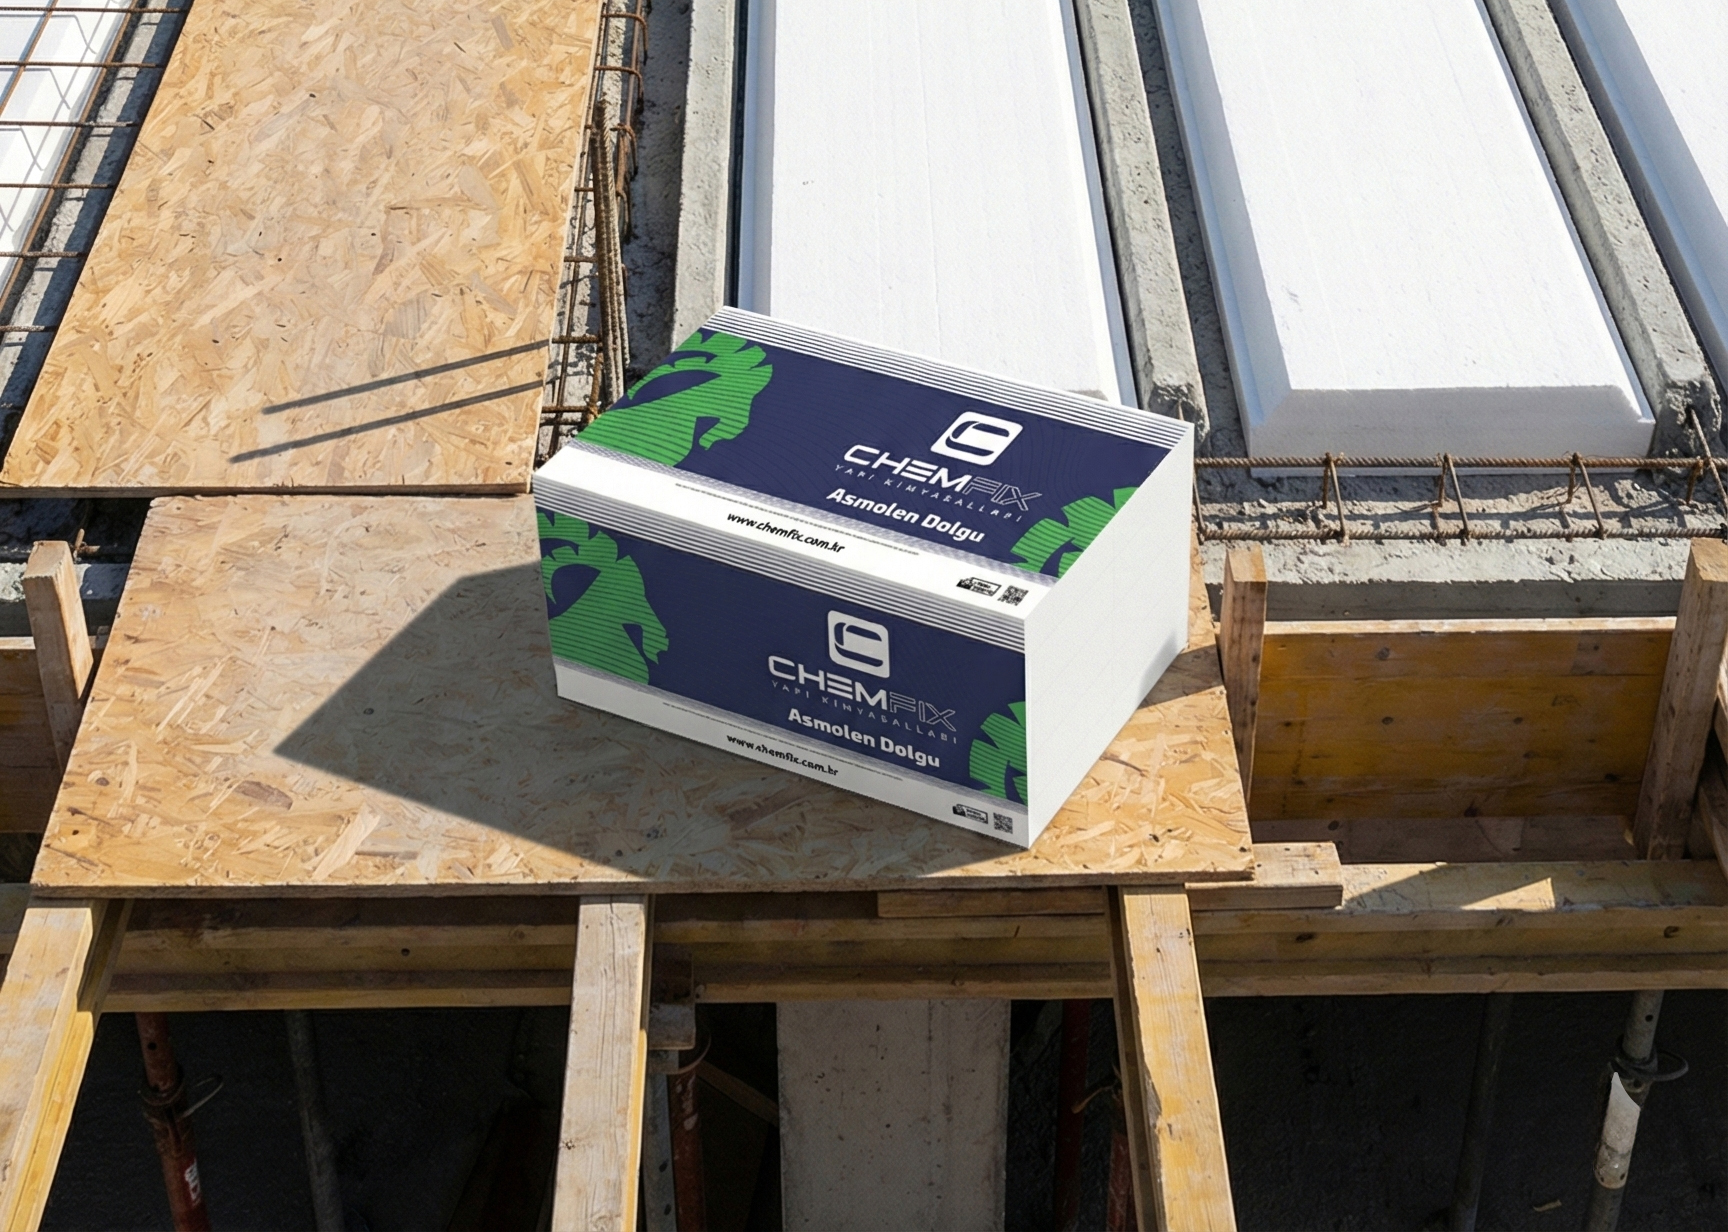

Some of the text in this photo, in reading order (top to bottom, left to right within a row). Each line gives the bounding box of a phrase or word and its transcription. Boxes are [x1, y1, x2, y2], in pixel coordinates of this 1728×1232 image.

[843, 444, 1043, 512] CHEMFIX
[826, 488, 920, 524] Asmolen
[921, 513, 985, 543] Dolgu
[768, 655, 957, 732] CHEMFIX
[788, 708, 875, 747] Asmolen
[880, 736, 940, 768] Dolgu
